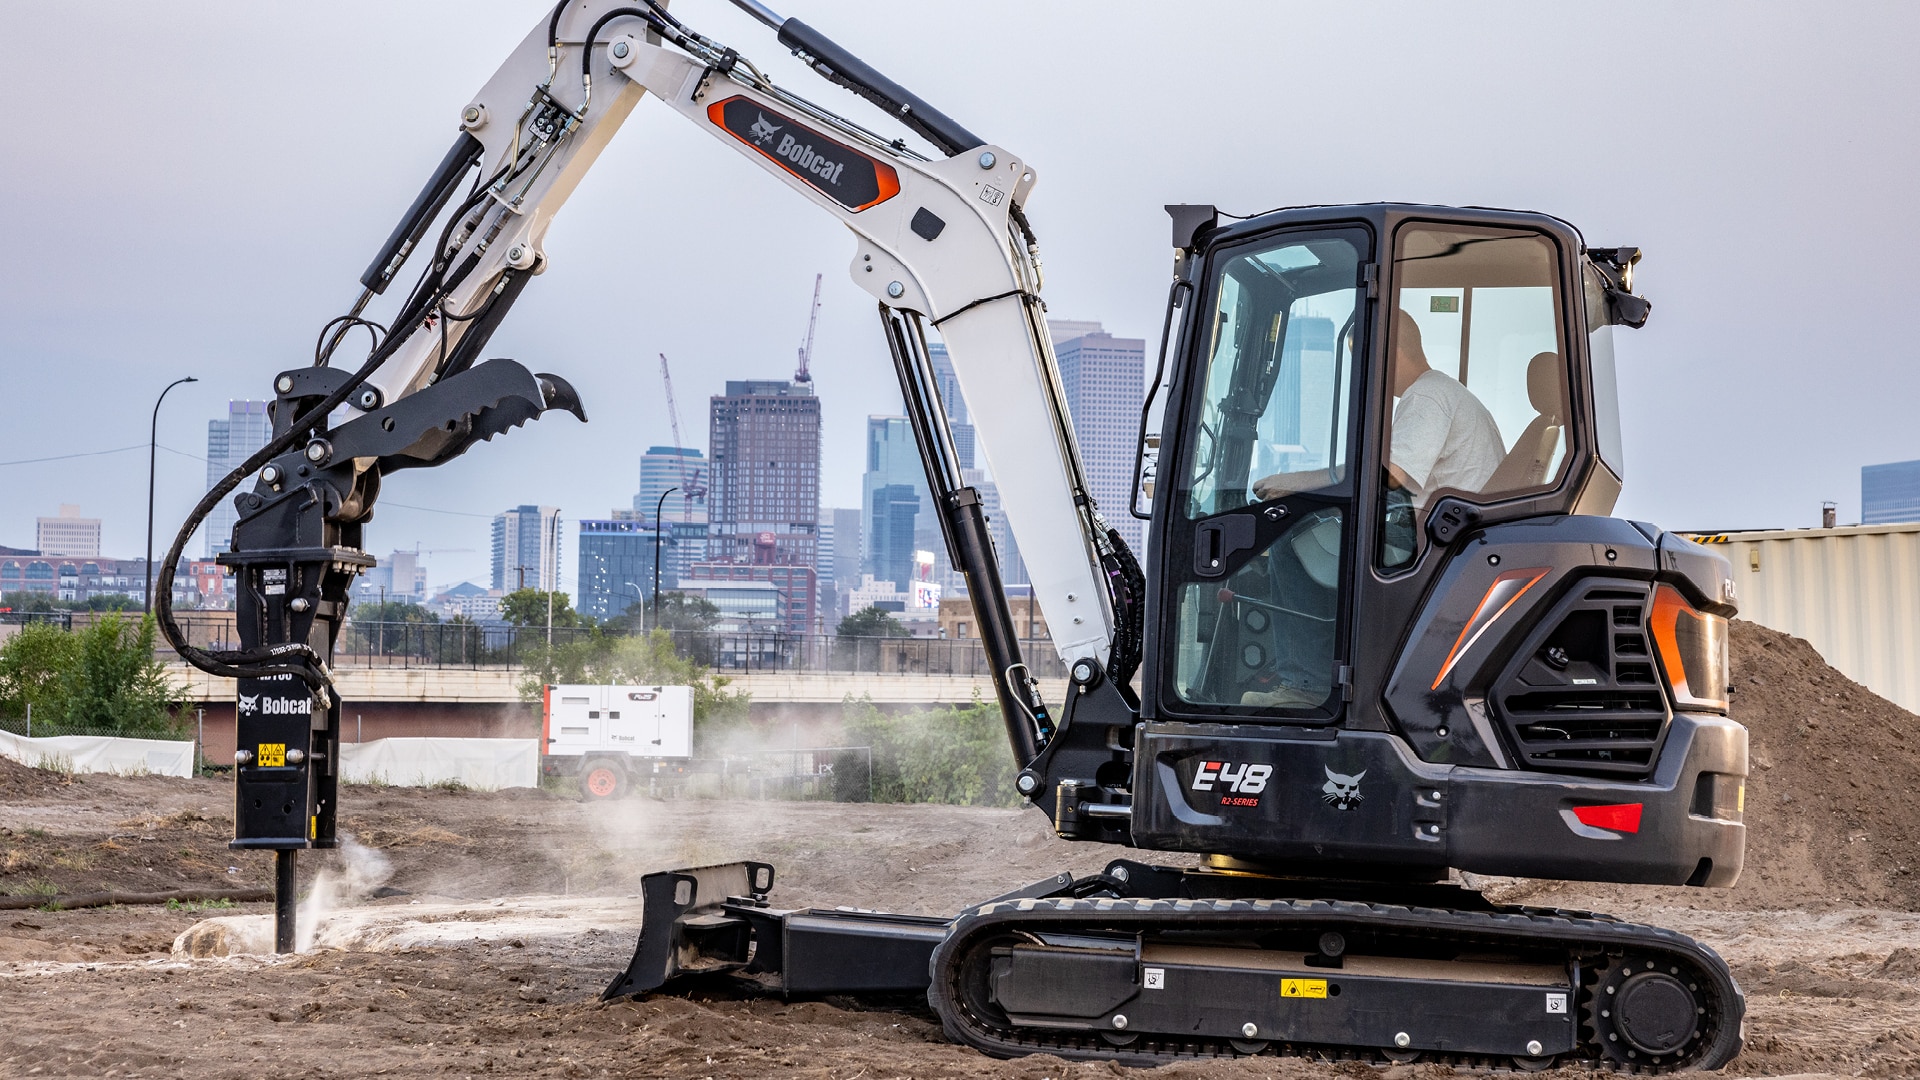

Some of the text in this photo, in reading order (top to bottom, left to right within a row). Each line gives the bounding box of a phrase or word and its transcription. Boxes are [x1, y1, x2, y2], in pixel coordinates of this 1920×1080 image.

[776, 133, 844, 185] Bobcat
[262, 696, 311, 715] Bobcat
[1191, 761, 1273, 794] E48
[1220, 797, 1258, 807] R2-SERIES
